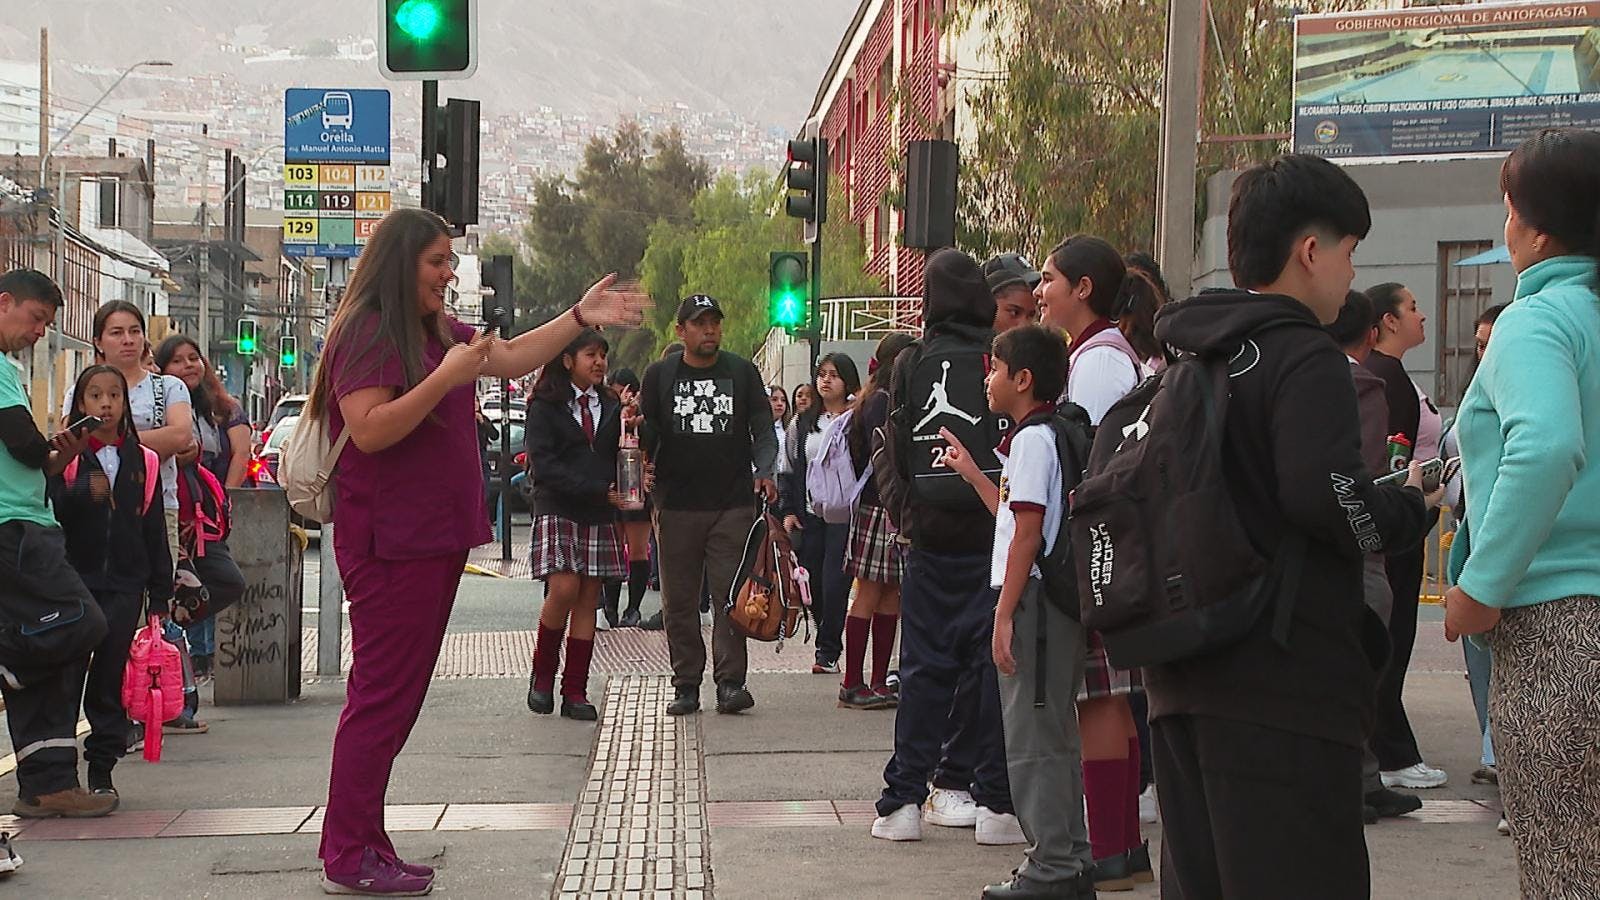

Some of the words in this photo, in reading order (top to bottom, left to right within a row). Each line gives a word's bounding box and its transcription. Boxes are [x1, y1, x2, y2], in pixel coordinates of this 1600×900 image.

[1336, 18, 1402, 31] GOBIERNO
[1404, 14, 1470, 28] REGIONAL
[1473, 12, 1490, 24] DE
[1493, 6, 1587, 22] ANTOFAGASTA
[320, 131, 354, 143] Orella
[301, 144, 330, 153] Manuel
[331, 144, 361, 153] Antonio
[363, 145, 385, 153] Matta
[288, 168, 313, 180] 103
[324, 168, 350, 181] 104
[361, 168, 385, 181] 112
[287, 194, 314, 207] 114
[323, 194, 350, 208] 119
[360, 195, 385, 208] 121
[288, 221, 313, 234] 129
[694, 296, 713, 307] LA
[679, 381, 709, 394] MY
[1098, 523, 1114, 585] UNDER
[1089, 527, 1104, 607] ARMOUR
